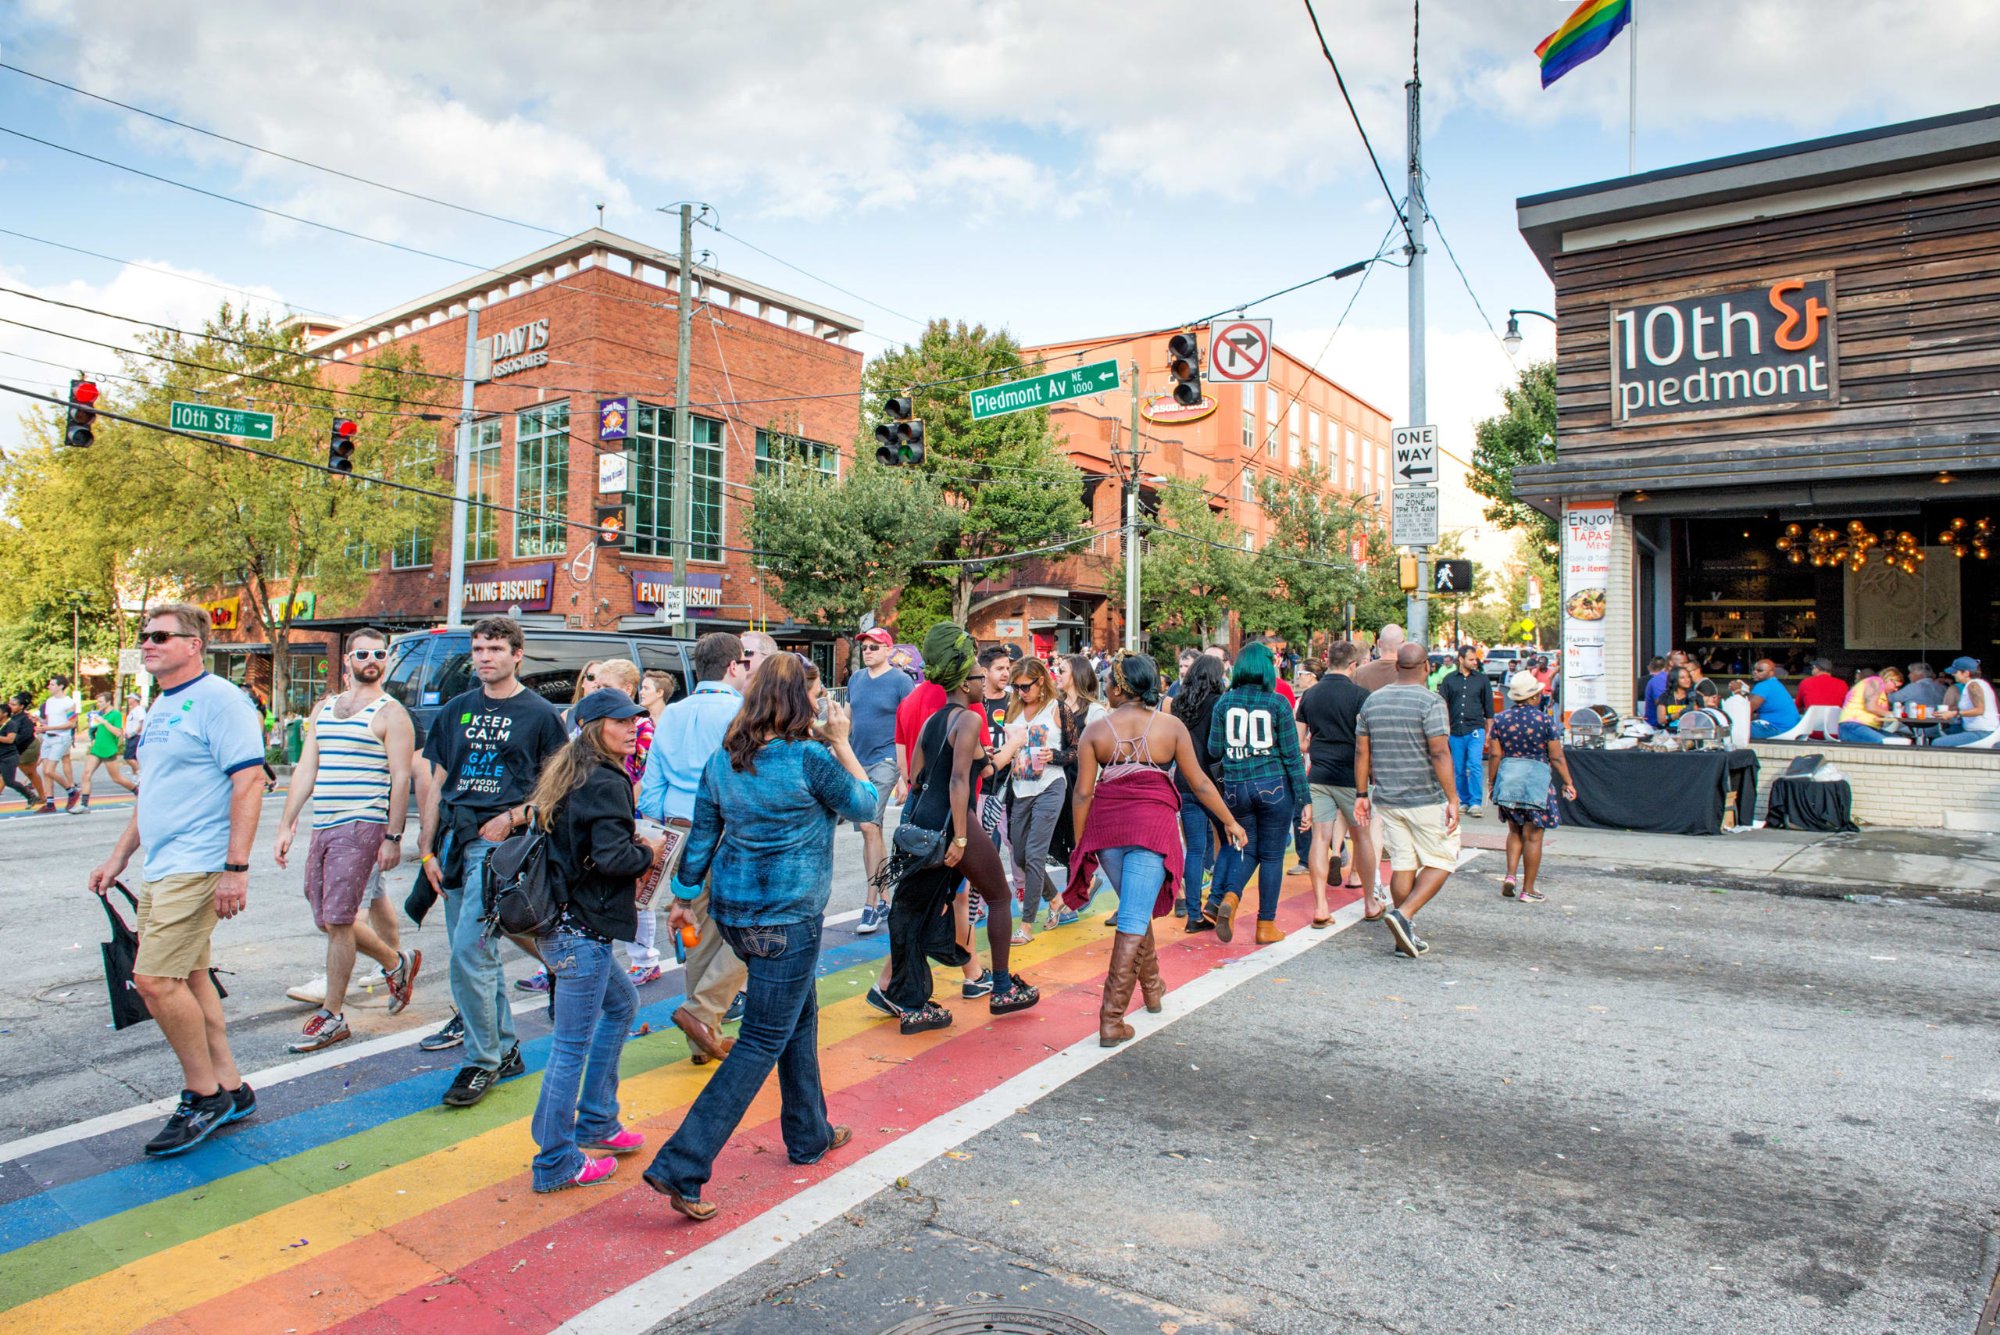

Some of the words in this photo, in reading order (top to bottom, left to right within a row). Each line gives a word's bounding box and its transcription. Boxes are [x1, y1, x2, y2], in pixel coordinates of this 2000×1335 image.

[1616, 302, 1761, 369] 10th
[1769, 280, 1829, 351] &
[493, 317, 549, 361] DAVIS
[492, 350, 548, 377] ASSOCIATES
[975, 383, 1042, 413] Piedmont
[1049, 379, 1066, 398] Av
[1071, 371, 1082, 382] NE
[1072, 381, 1093, 394] 1000
[1619, 355, 1828, 422] piedmont
[176, 407, 208, 428] 10th
[214, 412, 231, 431] St
[1397, 430, 1433, 445] ONE
[1397, 447, 1432, 462] WAY
[1395, 492, 1404, 500] NO
[1406, 491, 1435, 500] CRUISING
[1405, 499, 1426, 507] ZONE
[1569, 511, 1613, 526] ENJOY
[1571, 527, 1611, 541] TAPAS
[464, 581, 499, 602] FLYING
[500, 579, 544, 600] BISCUIT
[641, 582, 672, 603] FLYI
[667, 590, 680, 599] ONE
[472, 715, 512, 729] KEEP
[1226, 707, 1273, 749] 00
[465, 727, 511, 741] CALM
[469, 751, 499, 764] GAY
[471, 785, 502, 794] ABOUT
[639, 867, 661, 904] LOAFING
